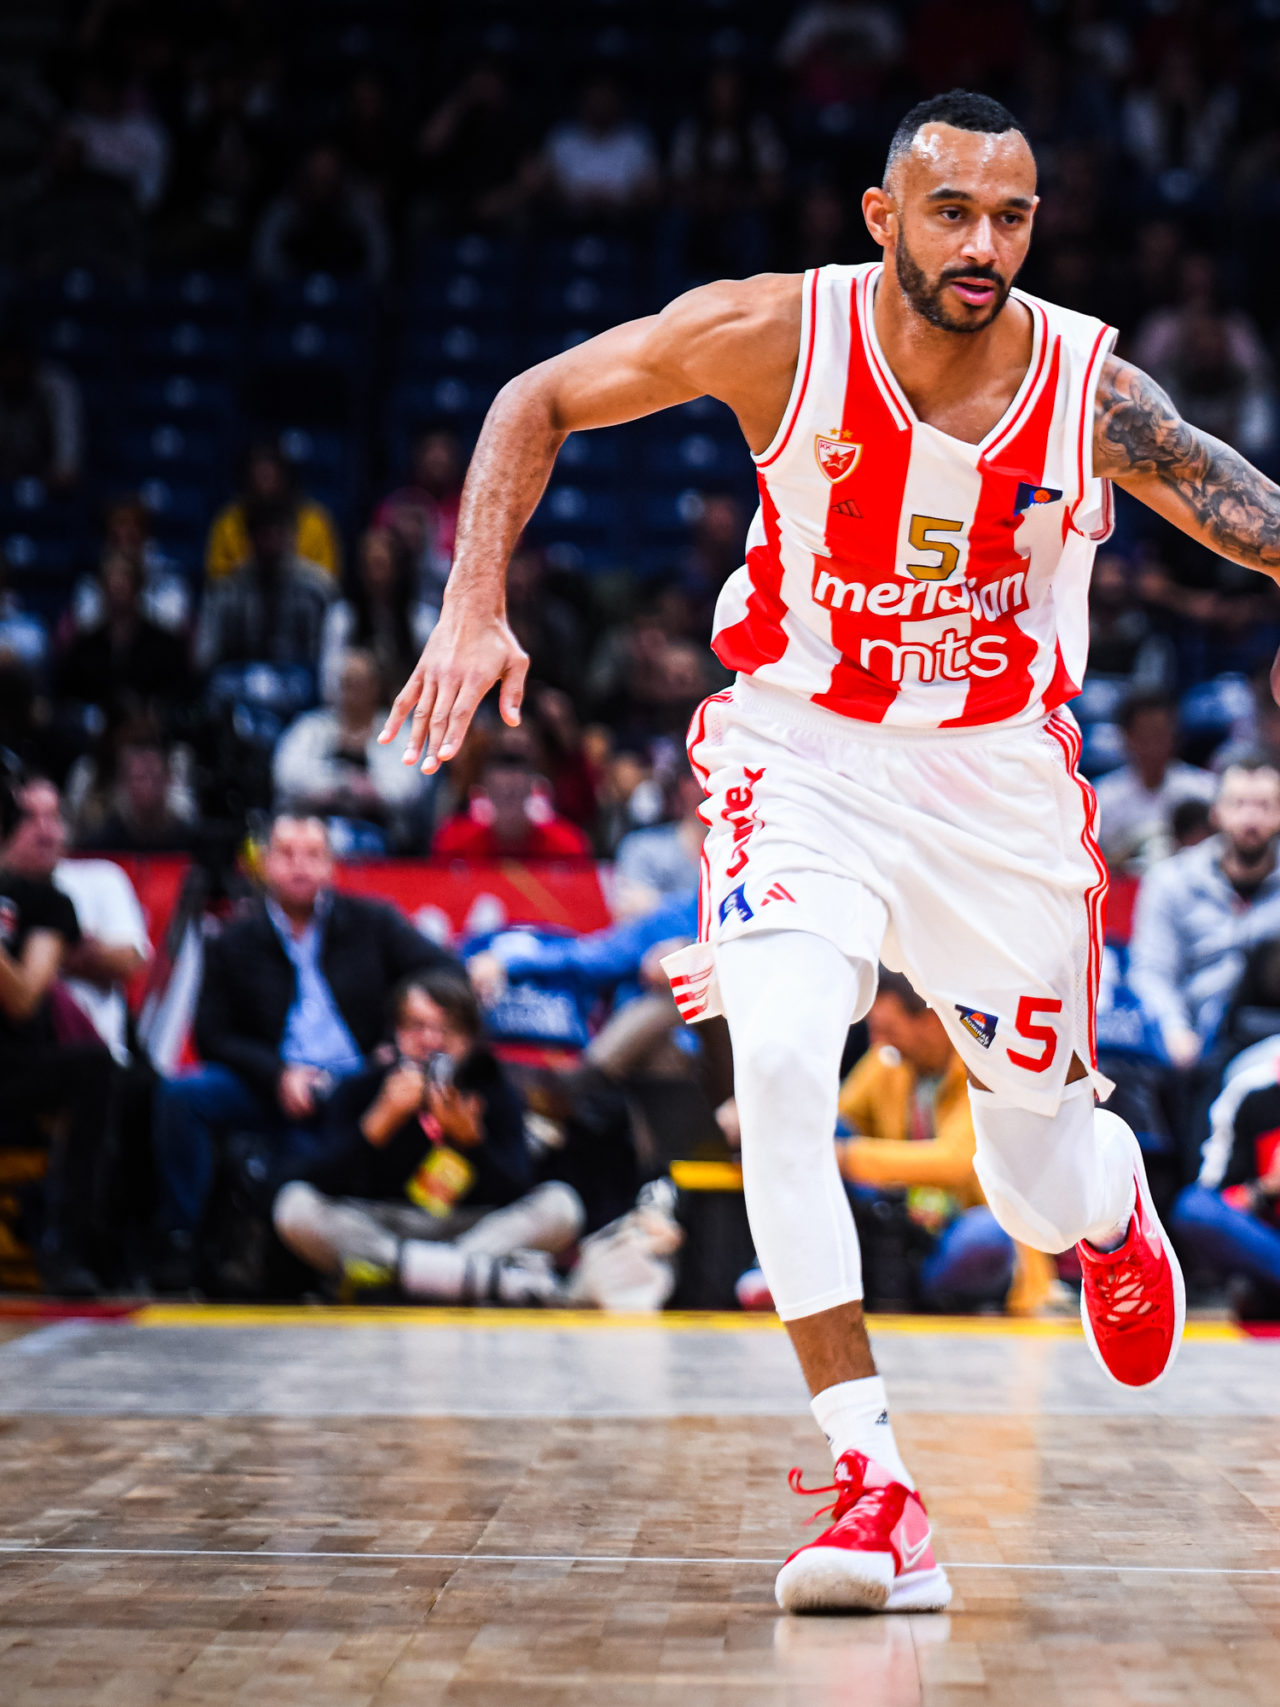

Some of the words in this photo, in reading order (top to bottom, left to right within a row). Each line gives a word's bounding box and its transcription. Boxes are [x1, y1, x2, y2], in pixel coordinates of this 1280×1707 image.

[907, 514, 963, 580] 5
[860, 628, 1008, 682] mts
[1006, 995, 1062, 1073] 5
